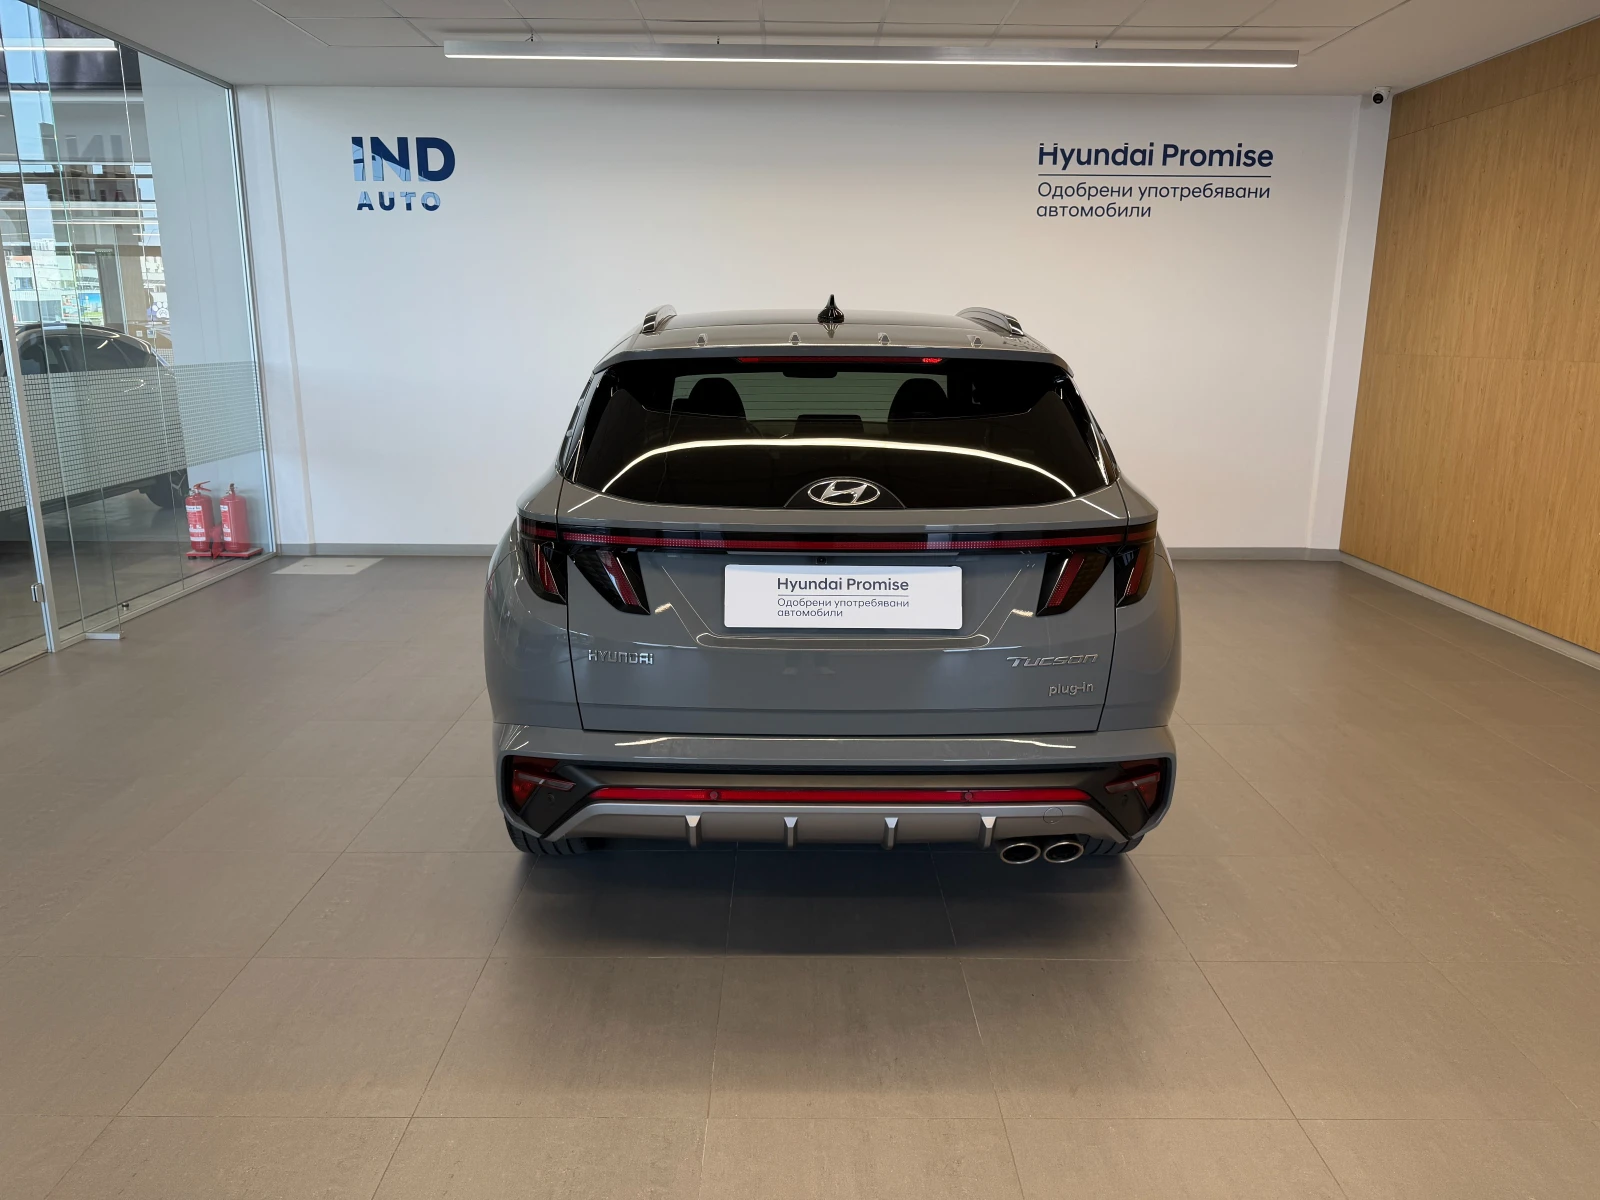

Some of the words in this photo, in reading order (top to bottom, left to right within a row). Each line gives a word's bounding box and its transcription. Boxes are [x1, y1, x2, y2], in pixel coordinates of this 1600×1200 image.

[351, 136, 456, 182] IND
[1038, 142, 1155, 170] Hyundai
[1161, 142, 1274, 168] Promise
[1037, 181, 1133, 200] Одобрени
[1138, 182, 1271, 201] употребявани
[356, 191, 441, 212] AUTO
[1036, 202, 1152, 217] автомобили
[777, 577, 843, 592] Hyundai
[846, 577, 909, 591] Promise
[777, 598, 832, 608] Одобрени
[834, 598, 910, 608] употребявани
[777, 608, 843, 617] автомобили
[588, 649, 653, 665] HYUNDAI
[1048, 681, 1095, 697] plug-in
